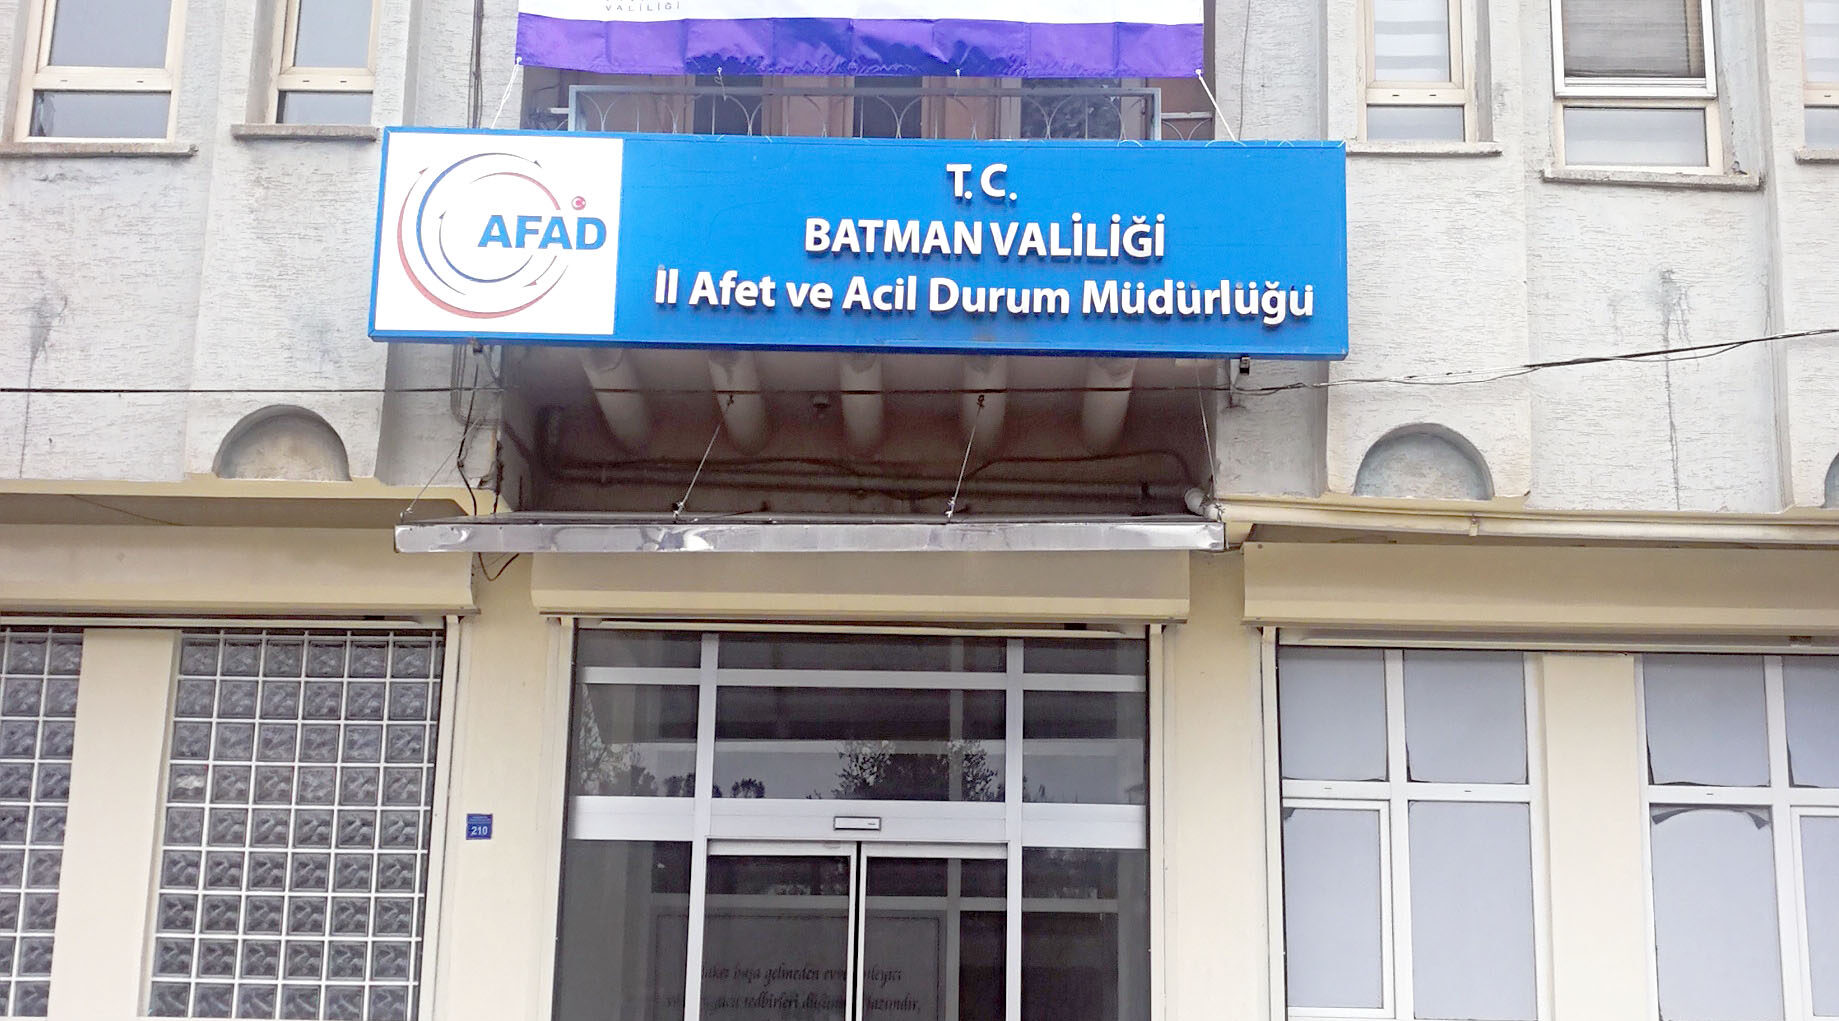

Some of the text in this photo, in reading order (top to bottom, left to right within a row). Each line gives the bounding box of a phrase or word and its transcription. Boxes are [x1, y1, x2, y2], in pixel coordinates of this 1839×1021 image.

[477, 214, 607, 250] AFAD
[804, 212, 1166, 258] BATMAN VALİLİĞİ
[688, 269, 776, 308] Afet
[785, 281, 834, 309] ve
[841, 275, 917, 311] Acil
[929, 277, 1070, 314] Durum
[1082, 279, 1314, 326] Müdürlüğü
[471, 826, 488, 836] 210
[763, 961, 820, 987] gelmeden
